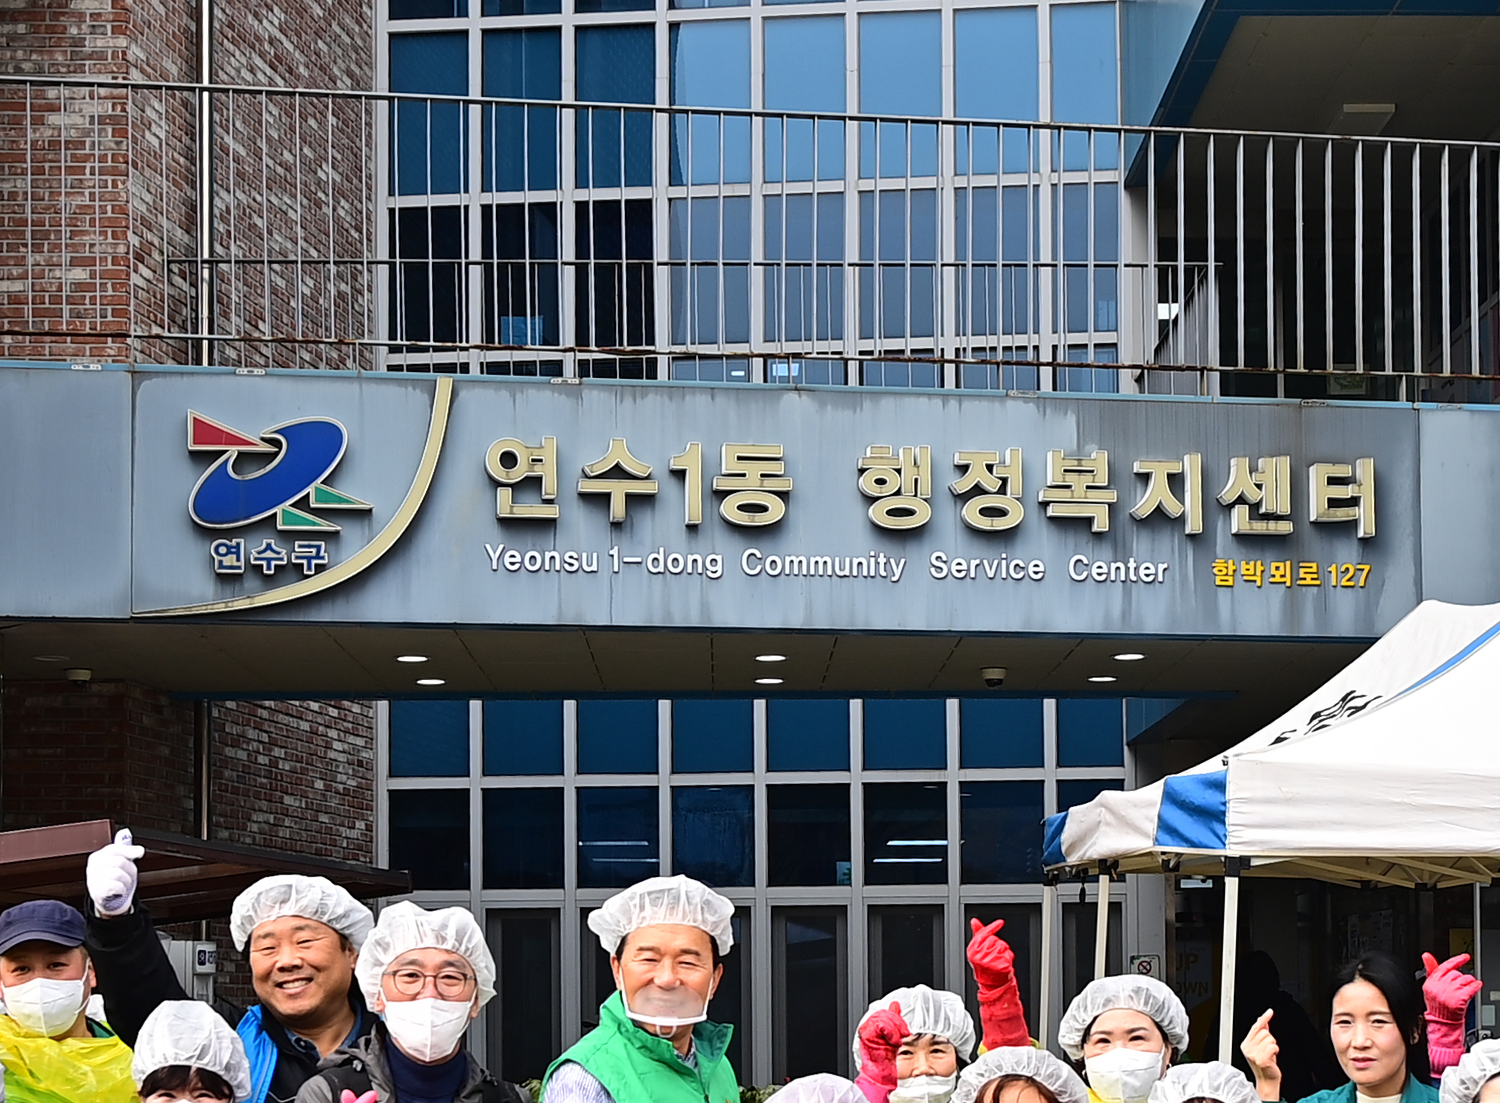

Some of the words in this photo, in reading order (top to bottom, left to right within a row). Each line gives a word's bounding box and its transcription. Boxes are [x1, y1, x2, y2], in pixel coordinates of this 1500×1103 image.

[485, 437, 794, 527] 연수1동
[858, 444, 1379, 540] 행정복지센터
[210, 538, 329, 575] 연수구
[484, 543, 599, 574] Yeonsu
[609, 546, 723, 580] 1-dong
[741, 549, 906, 582] Community
[929, 553, 1045, 581] Service
[1068, 554, 1167, 583] Center
[1327, 563, 1372, 587] 127
